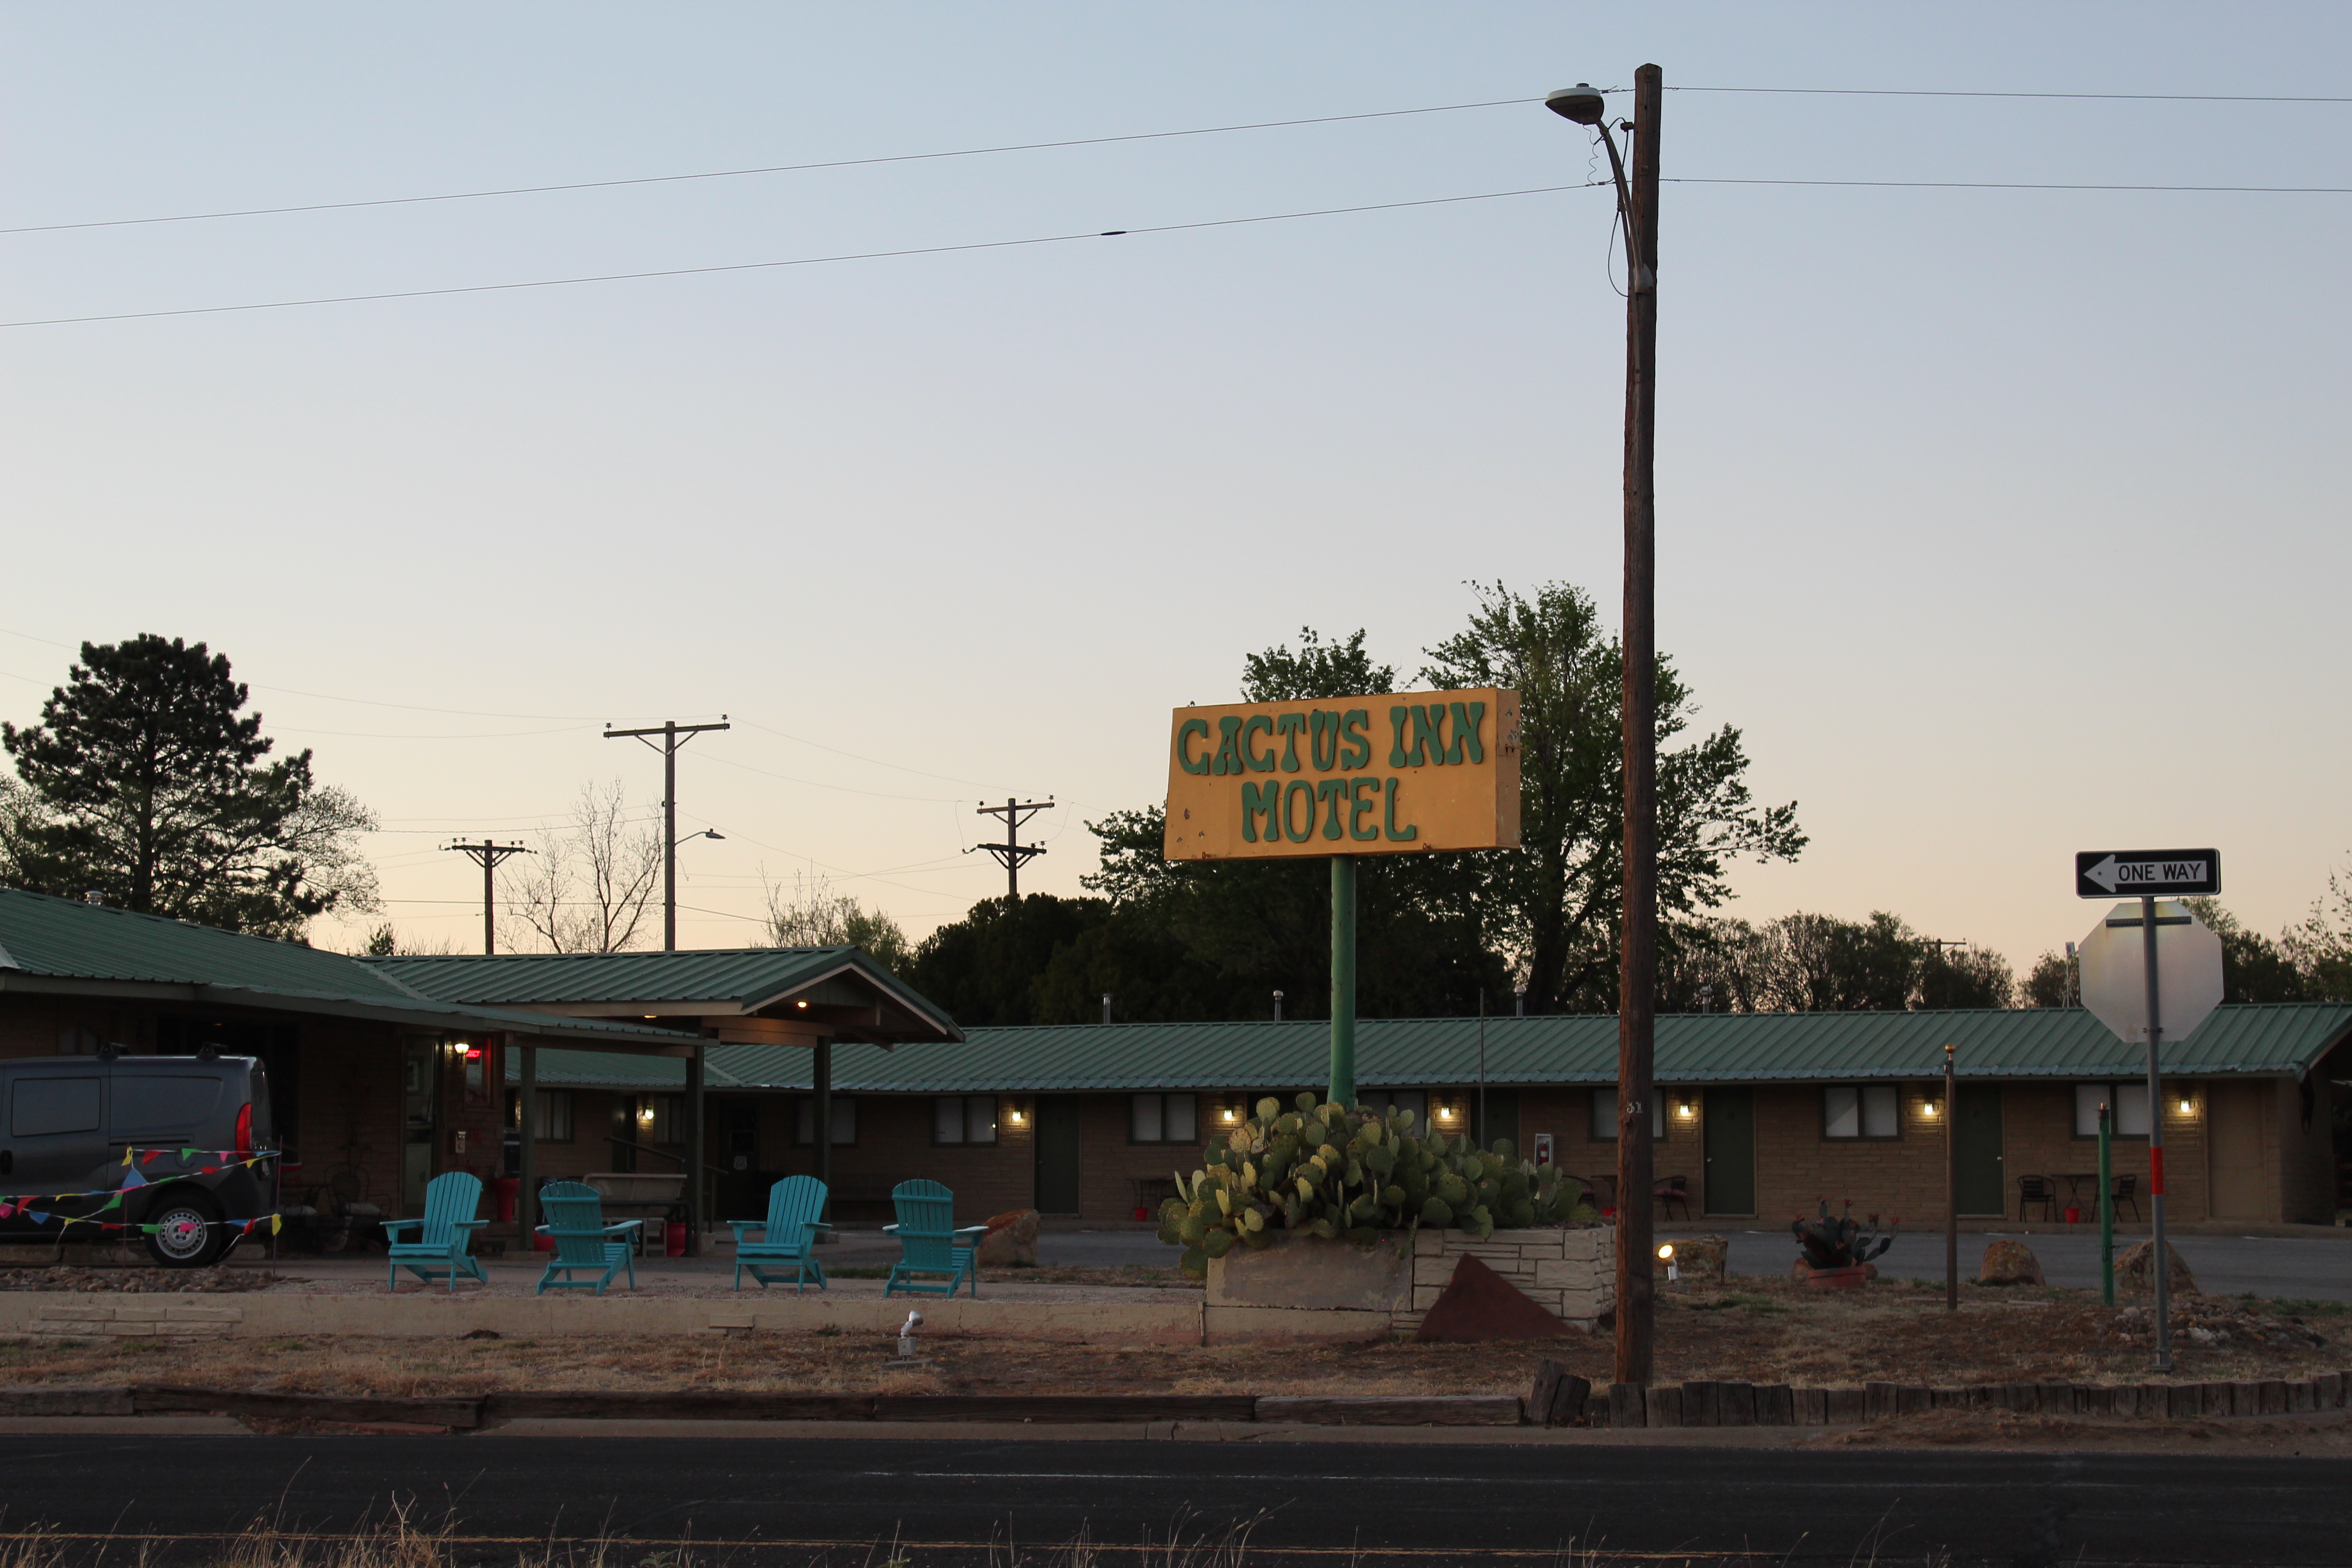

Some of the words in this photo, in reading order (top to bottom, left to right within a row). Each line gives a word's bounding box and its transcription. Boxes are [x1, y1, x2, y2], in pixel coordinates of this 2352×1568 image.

[1177, 708, 1369, 775] CACTUS
[1389, 701, 1484, 768] INN
[1241, 777, 1416, 843] MOTEL
[2118, 865, 2155, 881] ONE
[2163, 863, 2201, 880] WAY
